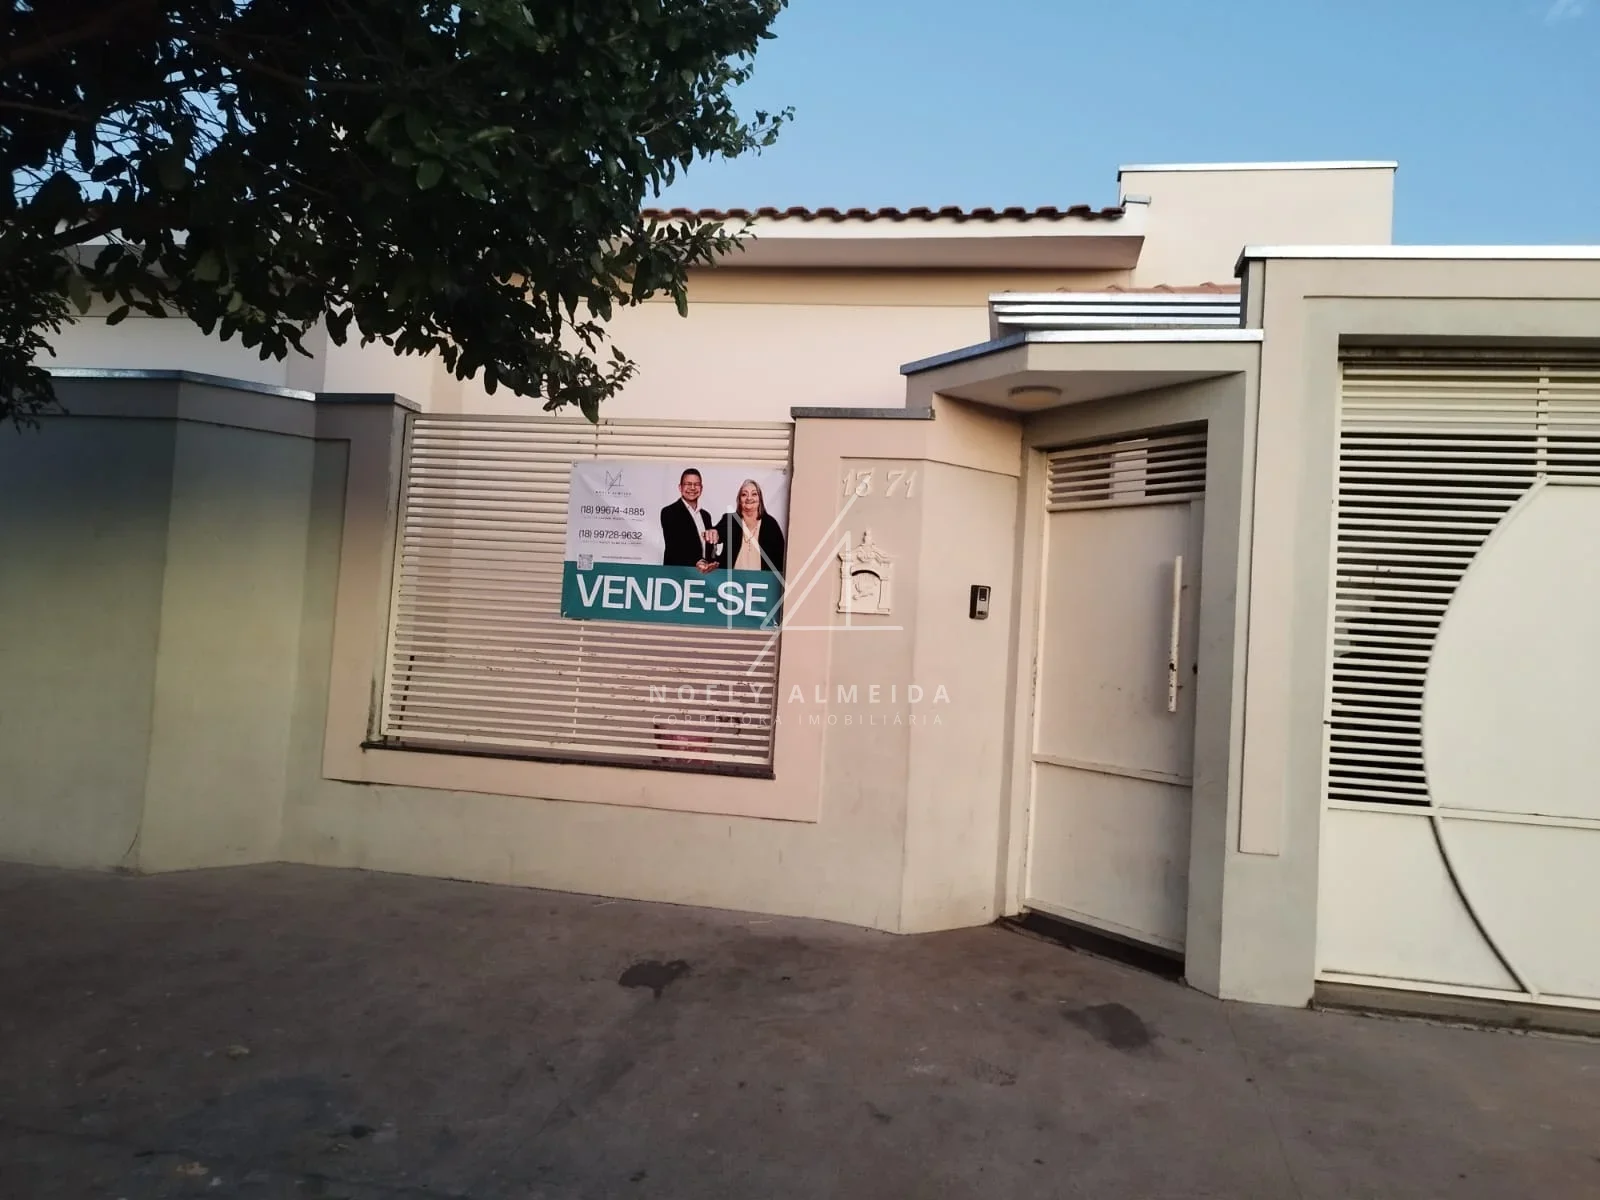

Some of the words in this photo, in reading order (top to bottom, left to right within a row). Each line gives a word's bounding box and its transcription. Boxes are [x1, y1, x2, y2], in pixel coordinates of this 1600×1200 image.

[580, 505, 594, 515] (18)
[595, 505, 645, 516] 99674-4885
[578, 529, 592, 539] (18)
[593, 530, 643, 541] 99728-9632
[576, 574, 769, 617] VENDE-SE
